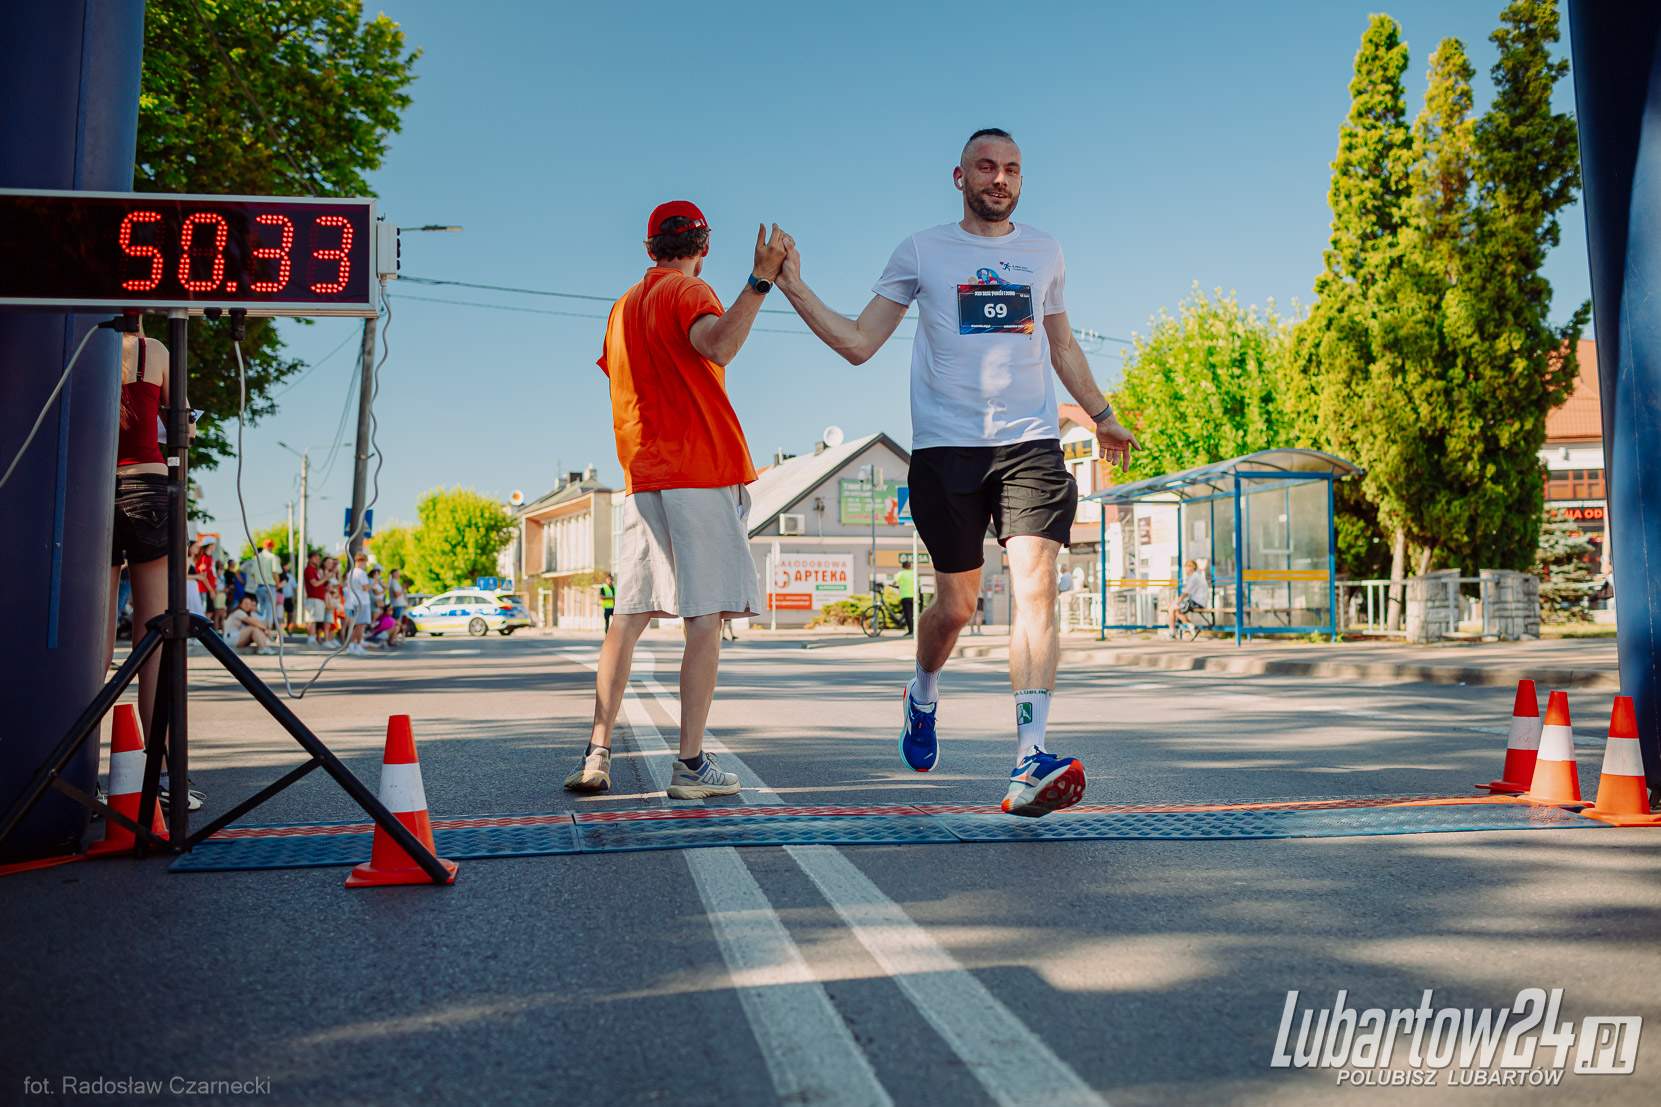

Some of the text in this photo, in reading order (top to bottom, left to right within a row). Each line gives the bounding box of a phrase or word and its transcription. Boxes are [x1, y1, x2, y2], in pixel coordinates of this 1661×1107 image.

[119, 210, 354, 293] 50.33
[984, 303, 1008, 318] 69
[794, 569, 847, 582] APTEKA
